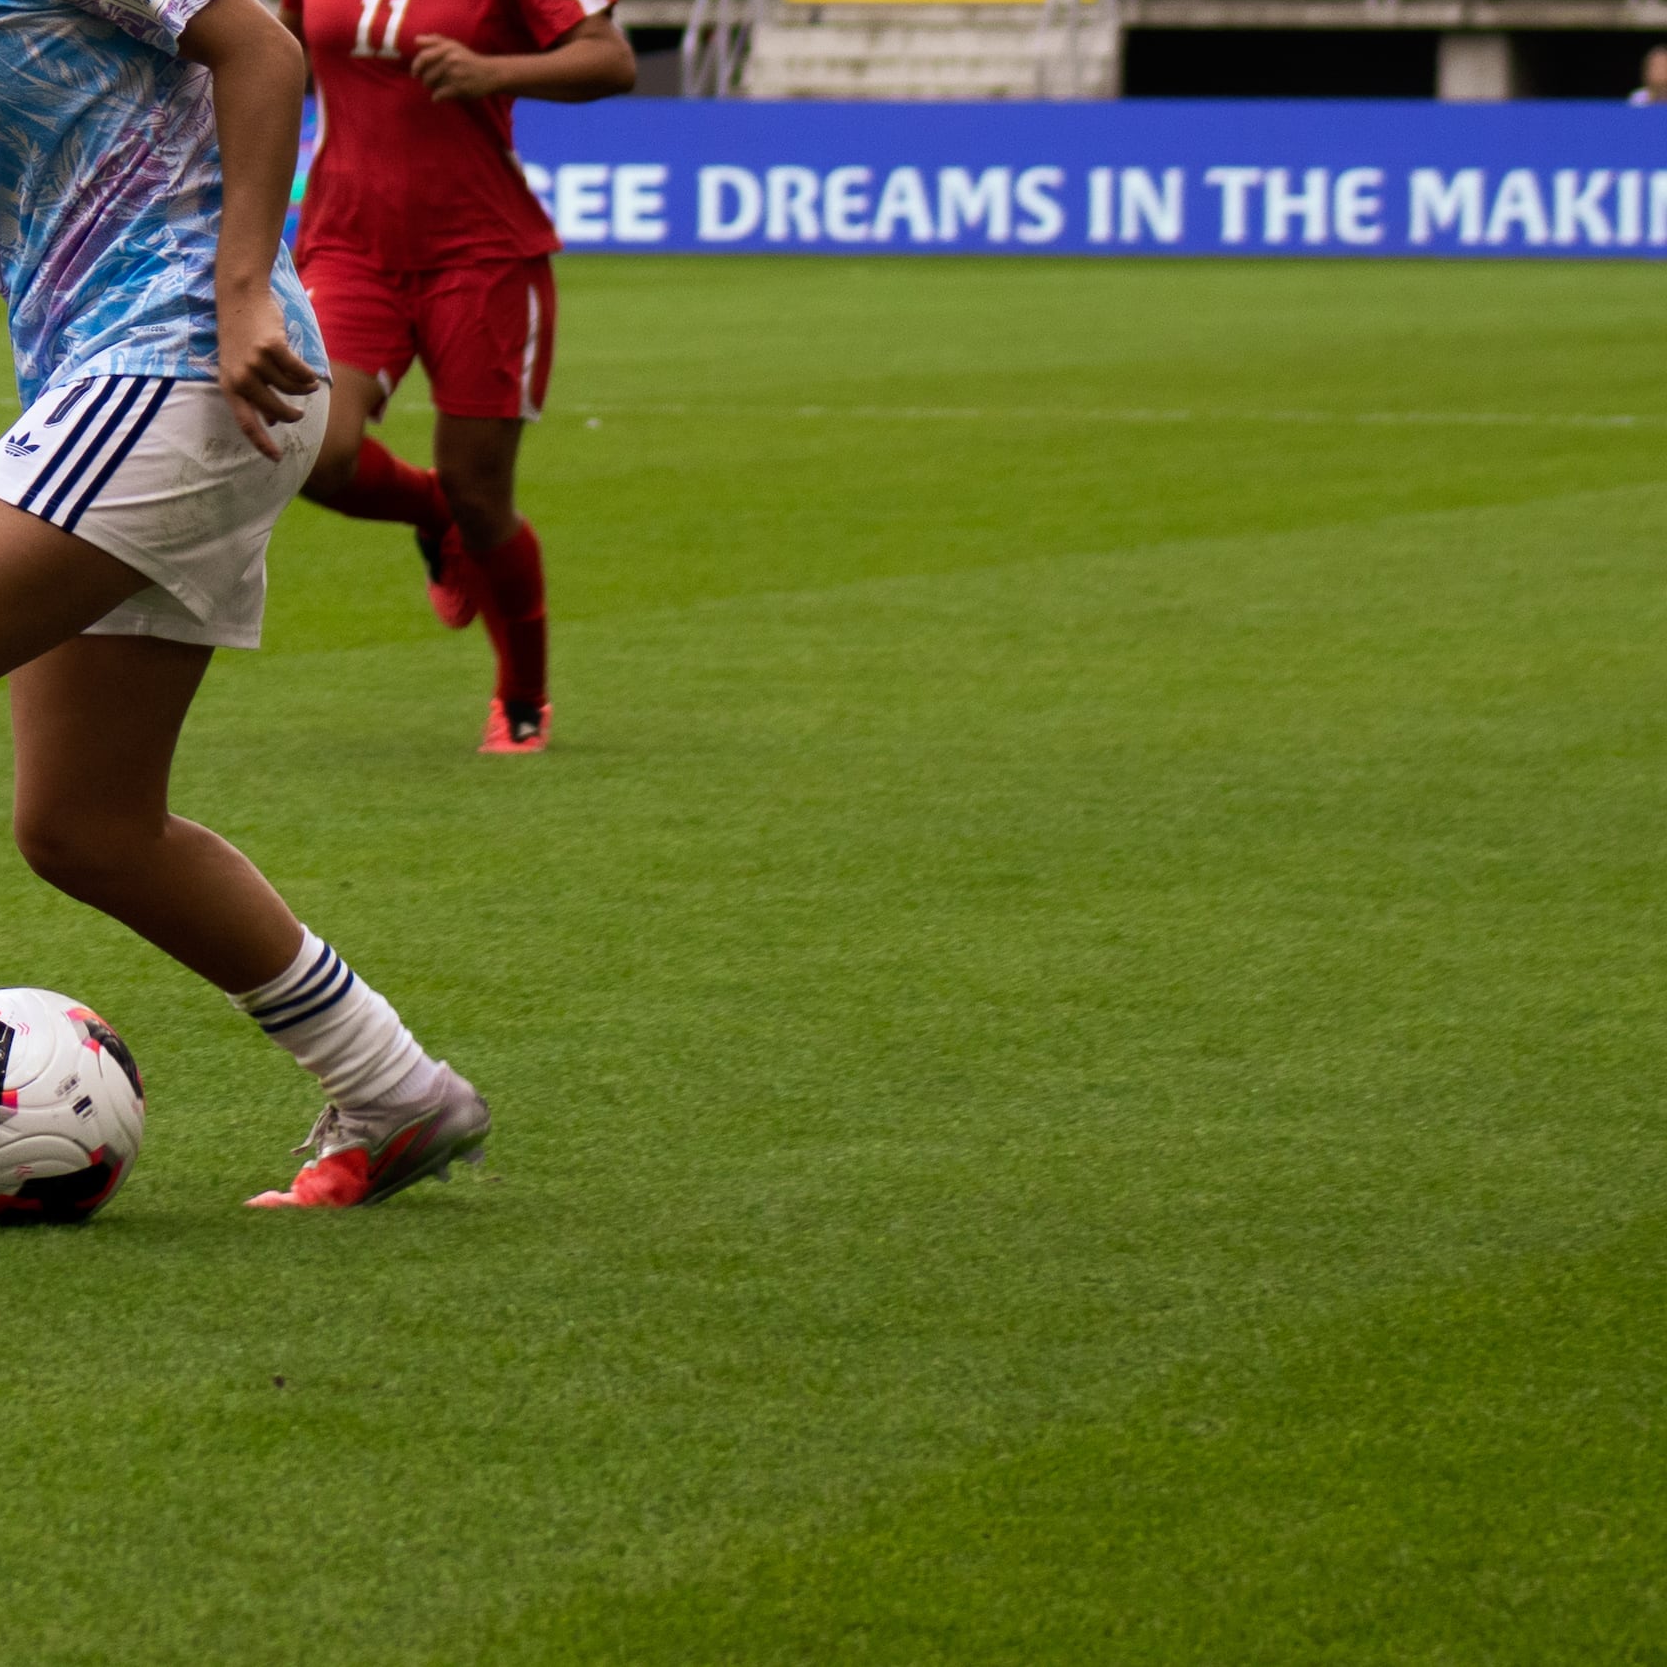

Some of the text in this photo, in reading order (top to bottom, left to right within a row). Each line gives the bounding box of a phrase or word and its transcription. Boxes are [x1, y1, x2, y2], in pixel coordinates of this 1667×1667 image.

[697, 164, 1065, 245] DREAMS
[1086, 165, 1185, 246] IN
[1204, 165, 1386, 246] THE
